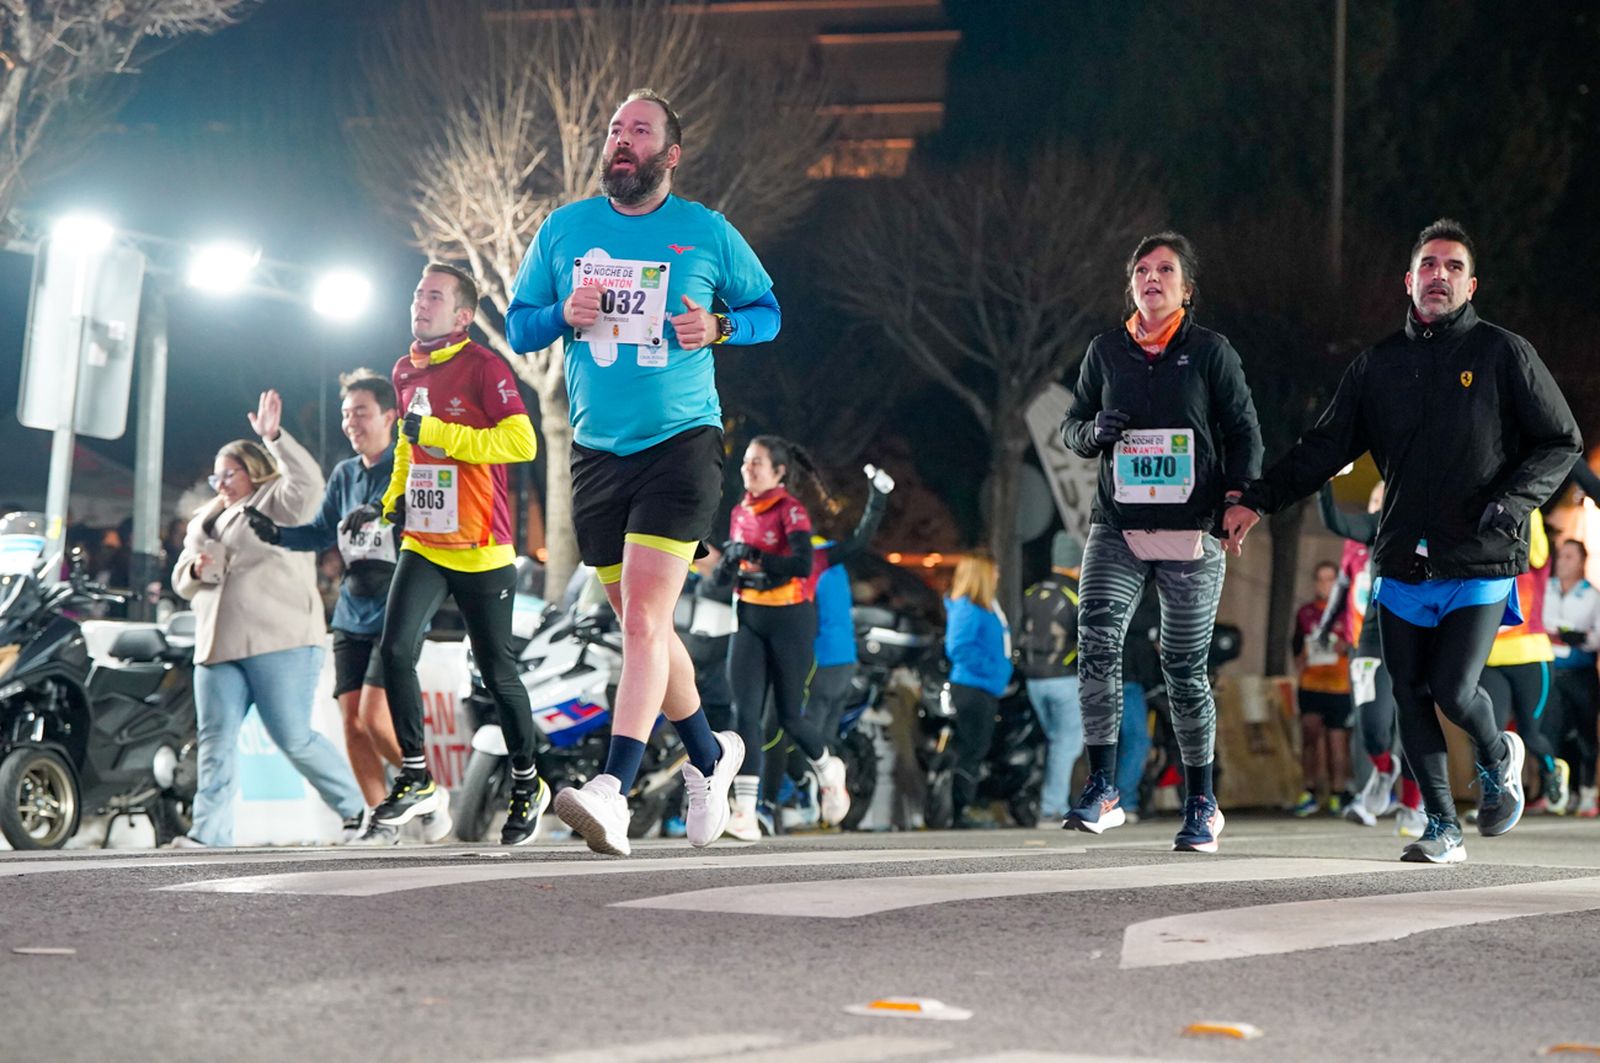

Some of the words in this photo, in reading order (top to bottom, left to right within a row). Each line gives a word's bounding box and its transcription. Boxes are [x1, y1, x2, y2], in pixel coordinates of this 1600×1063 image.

[593, 267, 621, 277] NOCHE
[621, 269, 633, 278] DE
[582, 277, 600, 287] SAN
[600, 288, 647, 315] 032
[1131, 437, 1154, 445] NOCHE
[1154, 437, 1164, 445] DE
[1122, 446, 1138, 454] SAN
[1131, 456, 1176, 477] 1870
[410, 489, 444, 510] 2803
[421, 691, 455, 735] AN
